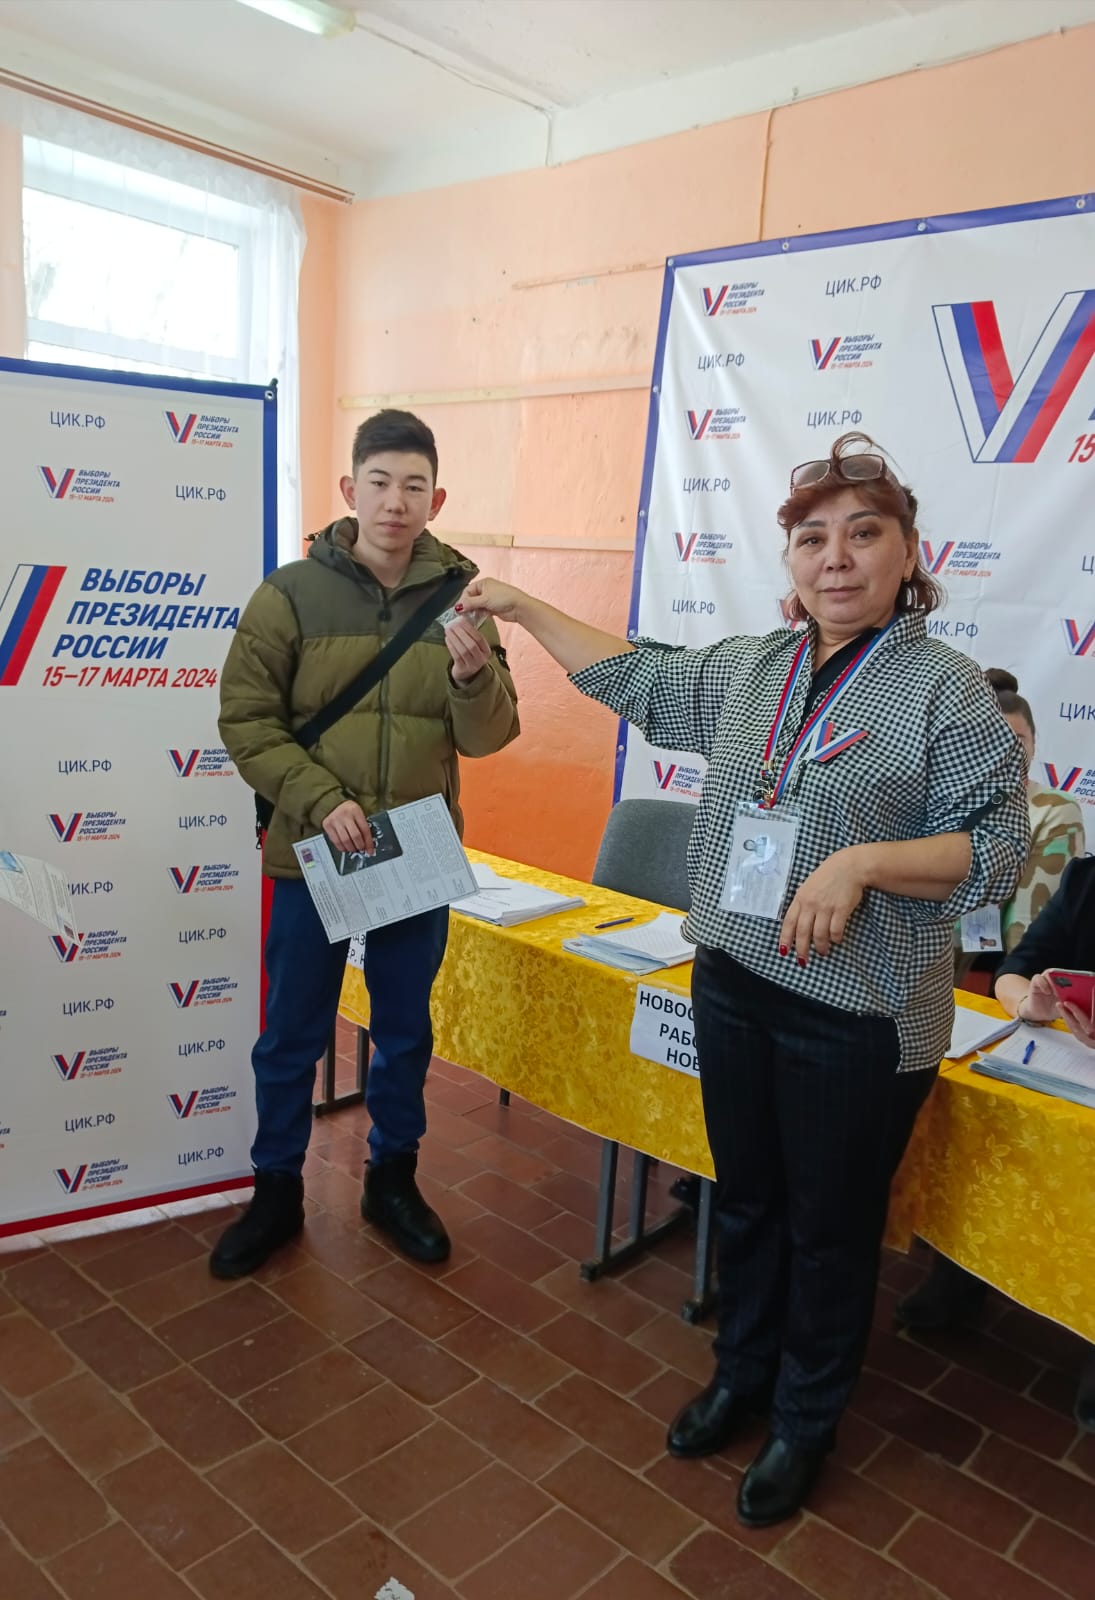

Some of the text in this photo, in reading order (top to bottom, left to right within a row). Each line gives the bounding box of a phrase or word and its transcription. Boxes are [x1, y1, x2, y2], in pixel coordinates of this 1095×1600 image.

[826, 275, 882, 298] ЦИК.РФ
[844, 335, 874, 343] ВЫБОРЫ
[839, 342, 882, 352] ПРЕЗИДЕНТА
[698, 354, 745, 370] ЦИК.РФ
[50, 411, 105, 429] ЦИК.РФ
[807, 410, 862, 428] ЦИК.РФ
[197, 424, 238, 433] ПРЕЗИДЕНТА
[78, 470, 110, 478] ВЫБОРЫ
[75, 478, 120, 488] ПРЕЗИДЕНТА
[683, 478, 730, 494] ЦИК.РФ
[176, 485, 226, 501] ЦИК.РФ
[958, 541, 992, 550] ВЫБОРЫ
[953, 551, 1000, 560] ПРЕЗИДЕНТА
[80, 568, 207, 596] ВЫБОРЫ
[672, 600, 715, 616] ЦИК.РФ
[66, 601, 240, 631] ПРЕЗИДЕНТА
[928, 620, 978, 638] ИК.РФ
[52, 634, 169, 659] РОССИИ
[101, 667, 169, 687] МАРТА
[171, 668, 218, 687] 2024
[58, 760, 112, 775] ЦИК.РФ
[83, 819, 126, 827] ПРЕЗИДЕНТА
[179, 814, 227, 830] ЦИК.РФ
[68, 881, 113, 895] ИК.РФ
[88, 930, 118, 938] ВЫБОРЫ
[179, 928, 226, 943] ЦИК.РФ
[84, 937, 127, 945] ПРЕЗИДЕНТА
[81, 946, 108, 954] РОССИИ
[202, 977, 230, 985] ВЫБОРЫ
[200, 983, 238, 992] ПРЕЗИДЕНТА
[63, 998, 114, 1016] ЦИК.РФ
[89, 1047, 119, 1056] ВЫБОРЫ
[178, 1039, 225, 1056] ЦИК.РФ
[86, 1053, 127, 1063] ПРЕЗИДЕНТА
[83, 1063, 109, 1071] РОССИИ
[202, 1086, 229, 1094] ВЫБОРЫ
[198, 1092, 236, 1101] ПРЕЗИДЕНТА
[195, 1101, 220, 1109] РОССИИ
[65, 1113, 115, 1133] ЦИК.РФ
[178, 1147, 224, 1166] ЦИК.РФ
[90, 1159, 120, 1169] ВЫБОРЫ
[88, 1164, 128, 1176] ПРЕЗИДЕНТА
[84, 1175, 111, 1184] РОССИИ
